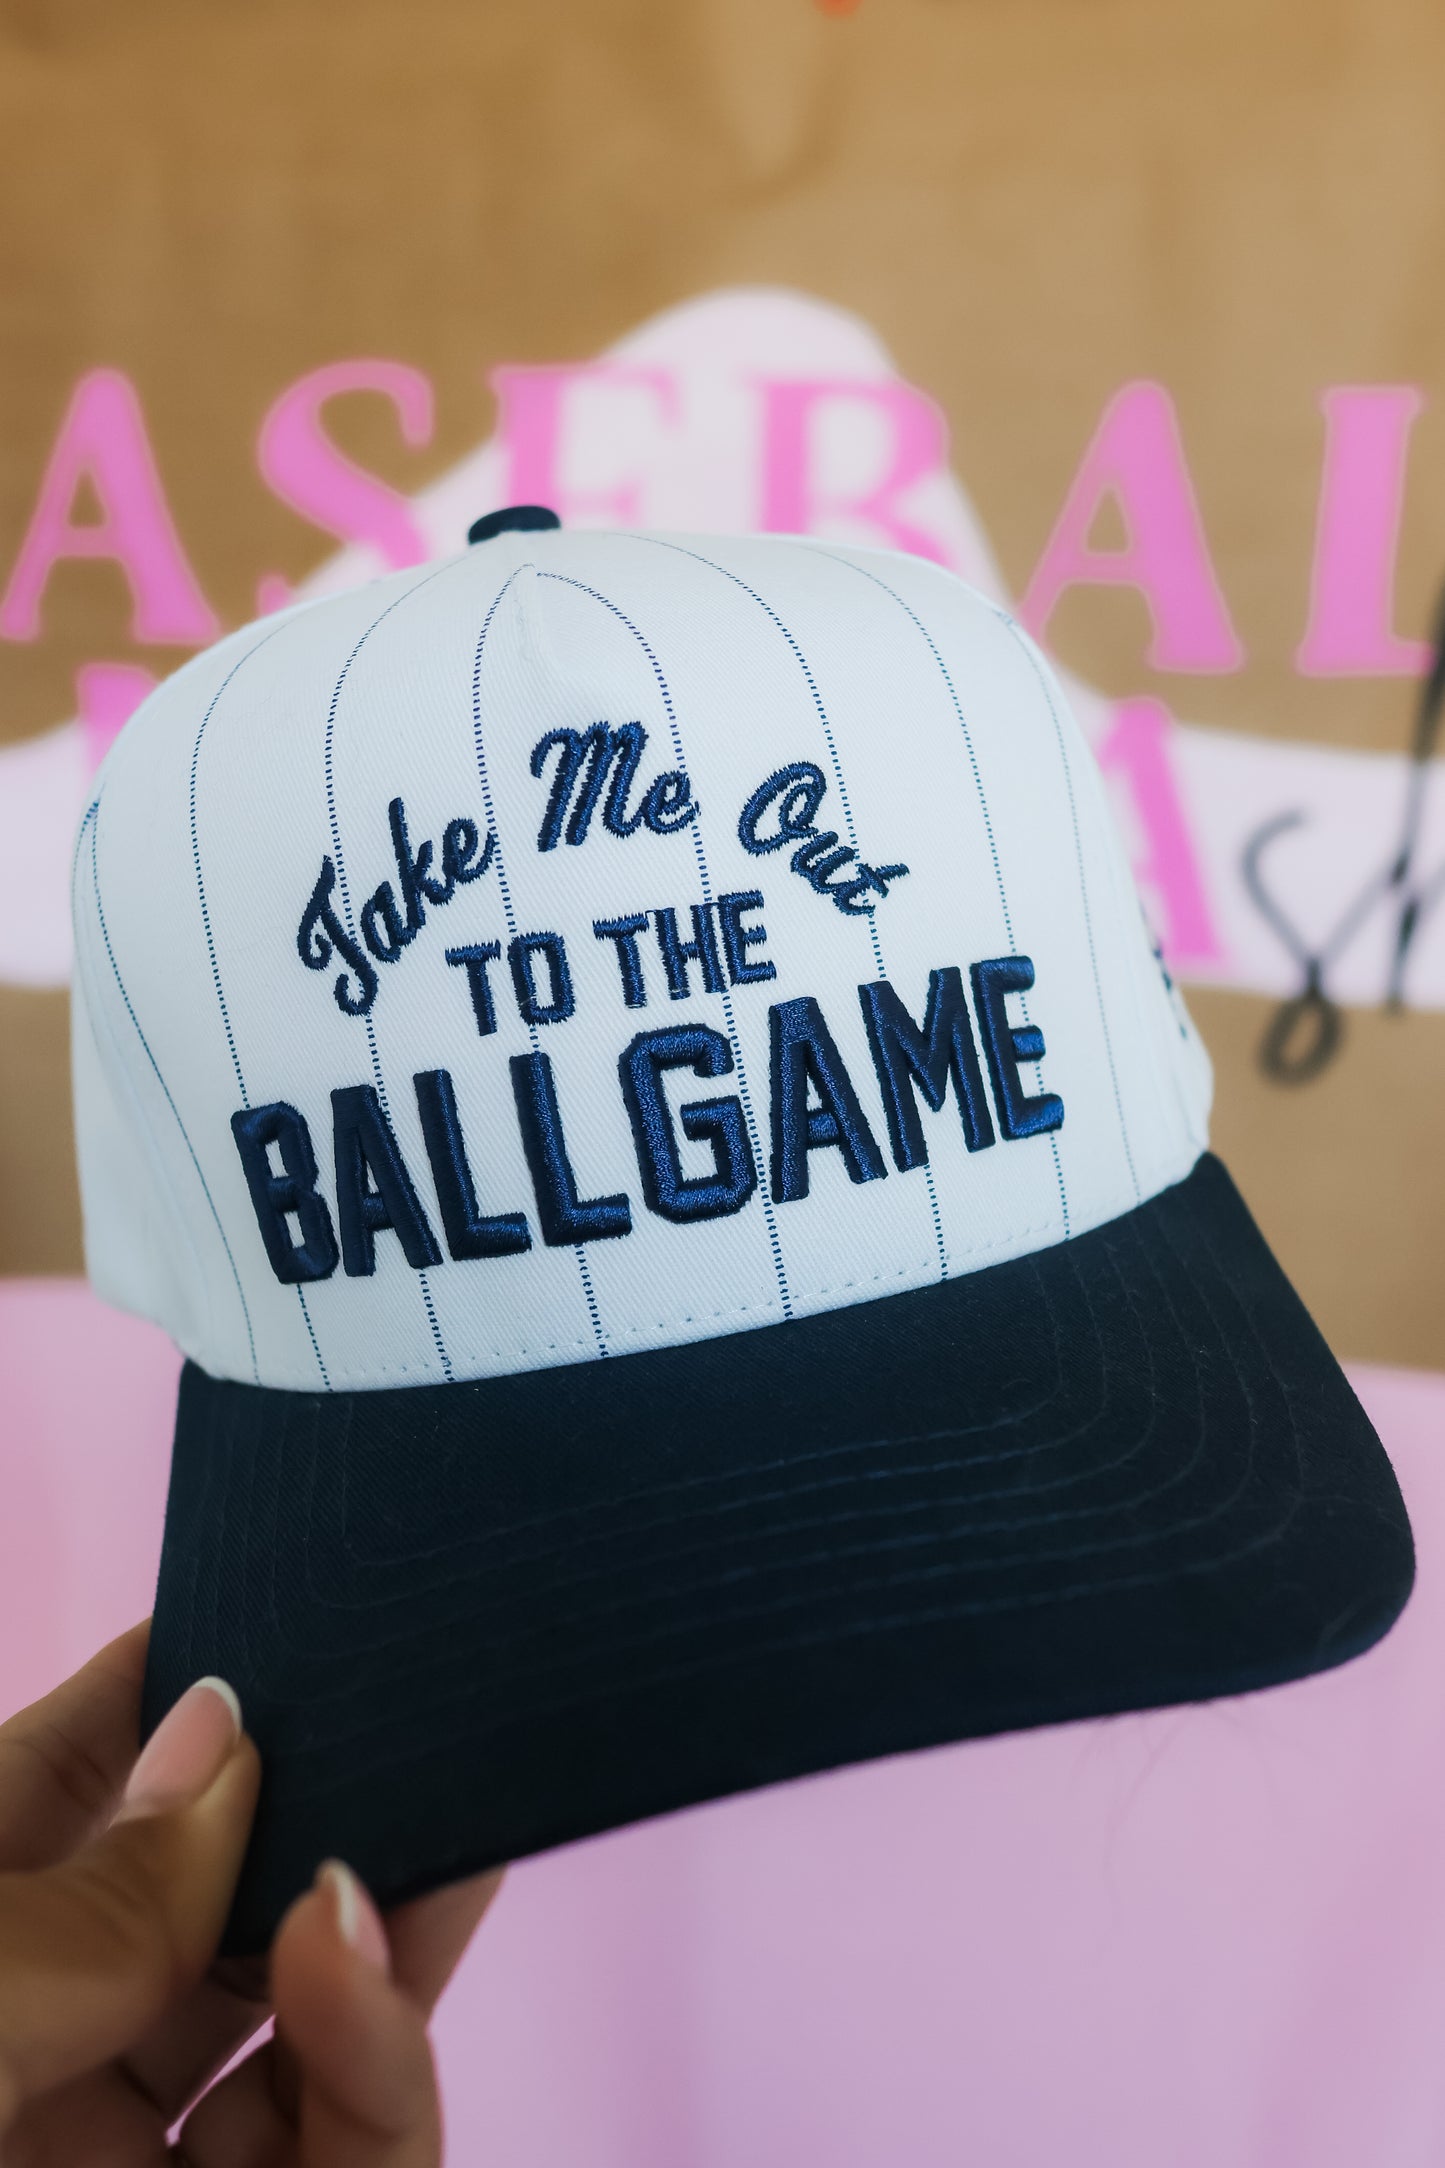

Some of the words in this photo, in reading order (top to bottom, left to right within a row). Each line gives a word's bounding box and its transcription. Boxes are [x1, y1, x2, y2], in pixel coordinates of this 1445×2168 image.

[297, 797, 498, 1017] Take
[530, 721, 698, 854] Me
[738, 761, 910, 917] Out
[445, 932, 573, 1037] TO
[594, 889, 778, 1010] THE
[230, 955, 1066, 1290] BALLGAME
